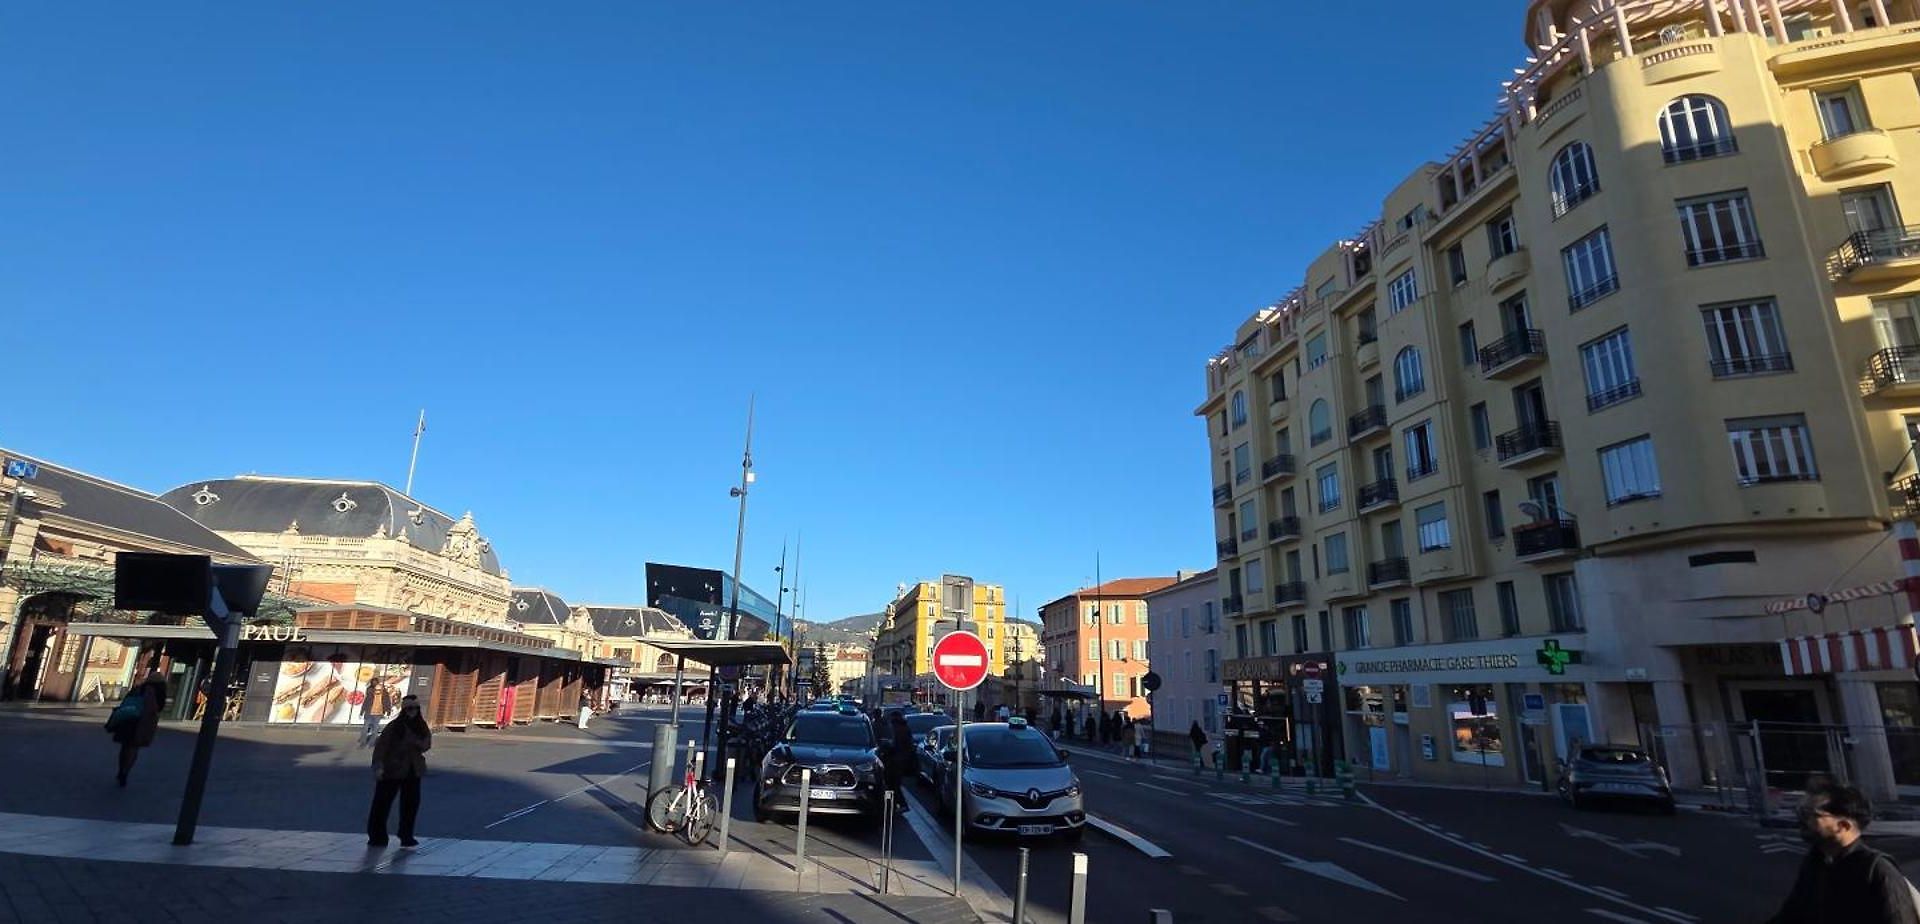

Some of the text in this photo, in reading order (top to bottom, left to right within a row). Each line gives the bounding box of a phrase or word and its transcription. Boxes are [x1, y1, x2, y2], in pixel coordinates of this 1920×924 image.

[243, 624, 306, 642] PAUL
[1355, 653, 1518, 674] GRANDE PHARMACIE GARE THIERS
